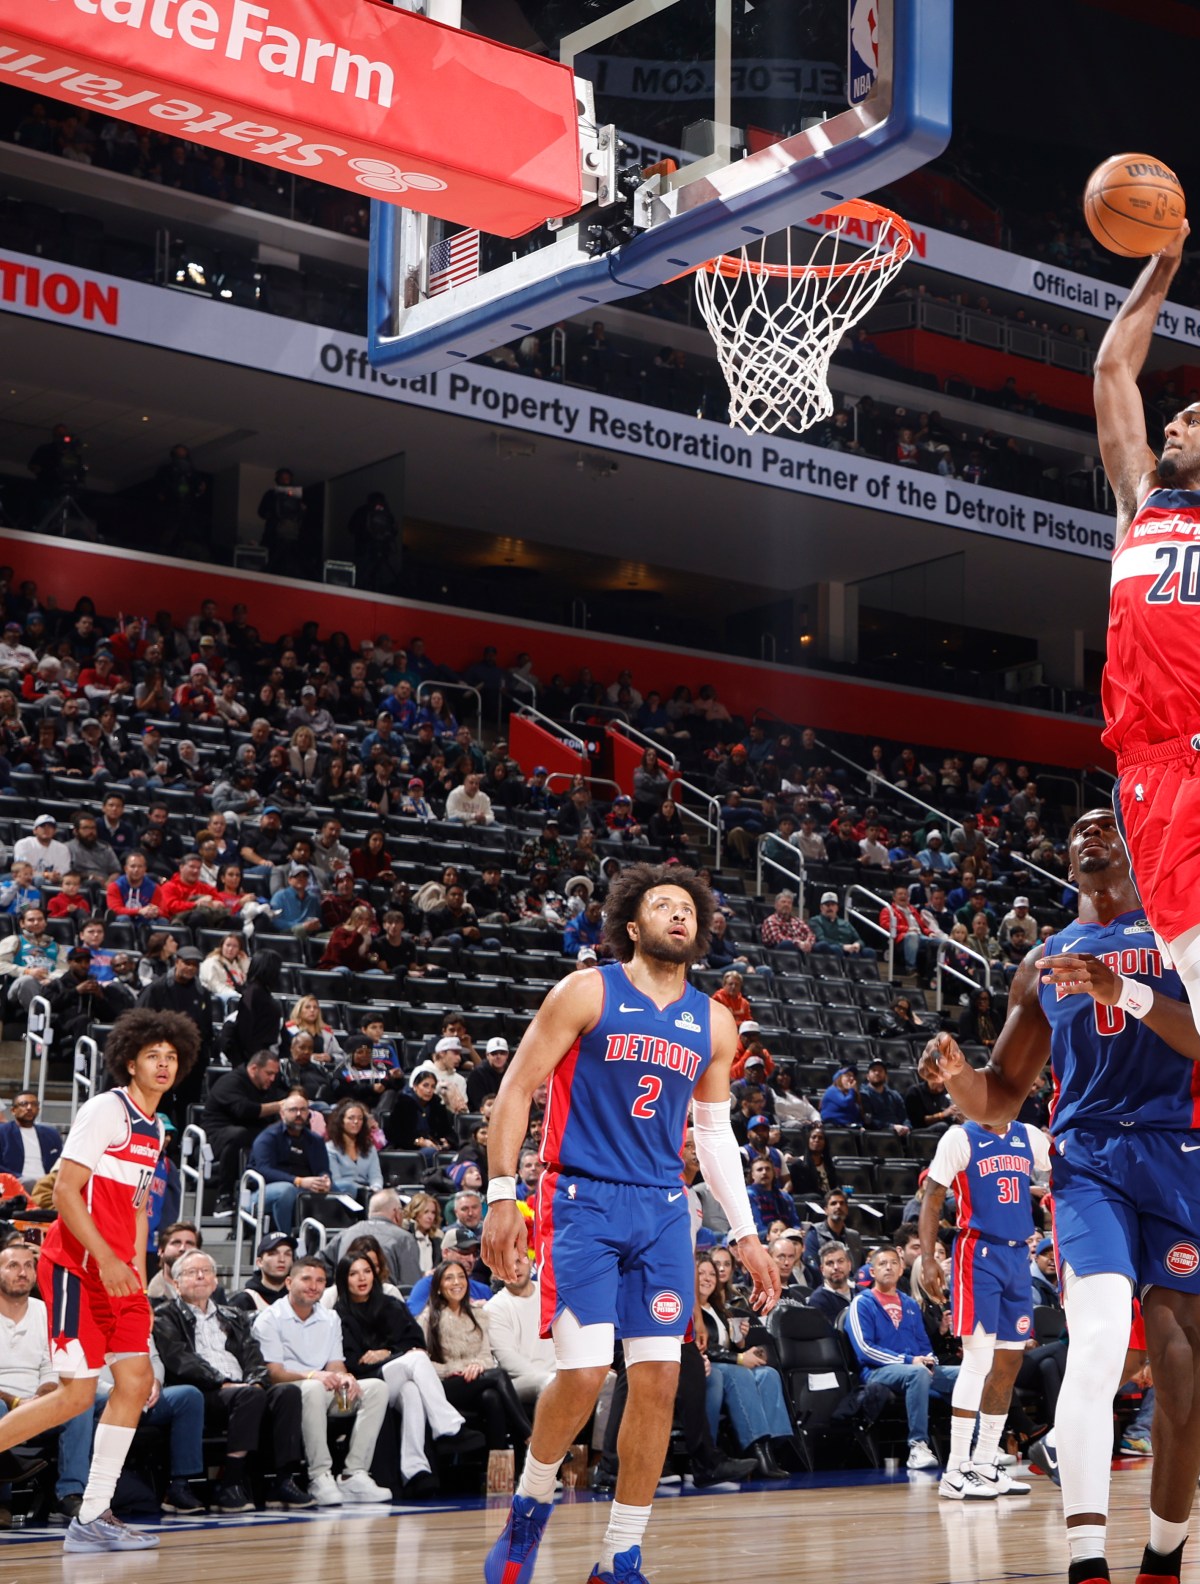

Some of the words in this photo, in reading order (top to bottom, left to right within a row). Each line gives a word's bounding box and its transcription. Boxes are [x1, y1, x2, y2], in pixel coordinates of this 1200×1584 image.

[74, 0, 395, 108] ateFarm
[0, 46, 348, 167] StateFar
[853, 72, 872, 99] NBA
[1033, 270, 1098, 308] Official
[1105, 292, 1179, 335] Prrty
[449, 372, 579, 433] Property
[588, 406, 753, 470] Restoration
[762, 446, 858, 493] Partner
[866, 472, 891, 500] of
[898, 479, 937, 510] the
[944, 492, 1026, 533] Detroit
[1033, 512, 1114, 551] Pistons
[605, 1033, 702, 1082] DETROIT
[631, 1074, 663, 1120] 2
[976, 1155, 1030, 1177] DETROIT
[997, 1176, 1020, 1204] 31
